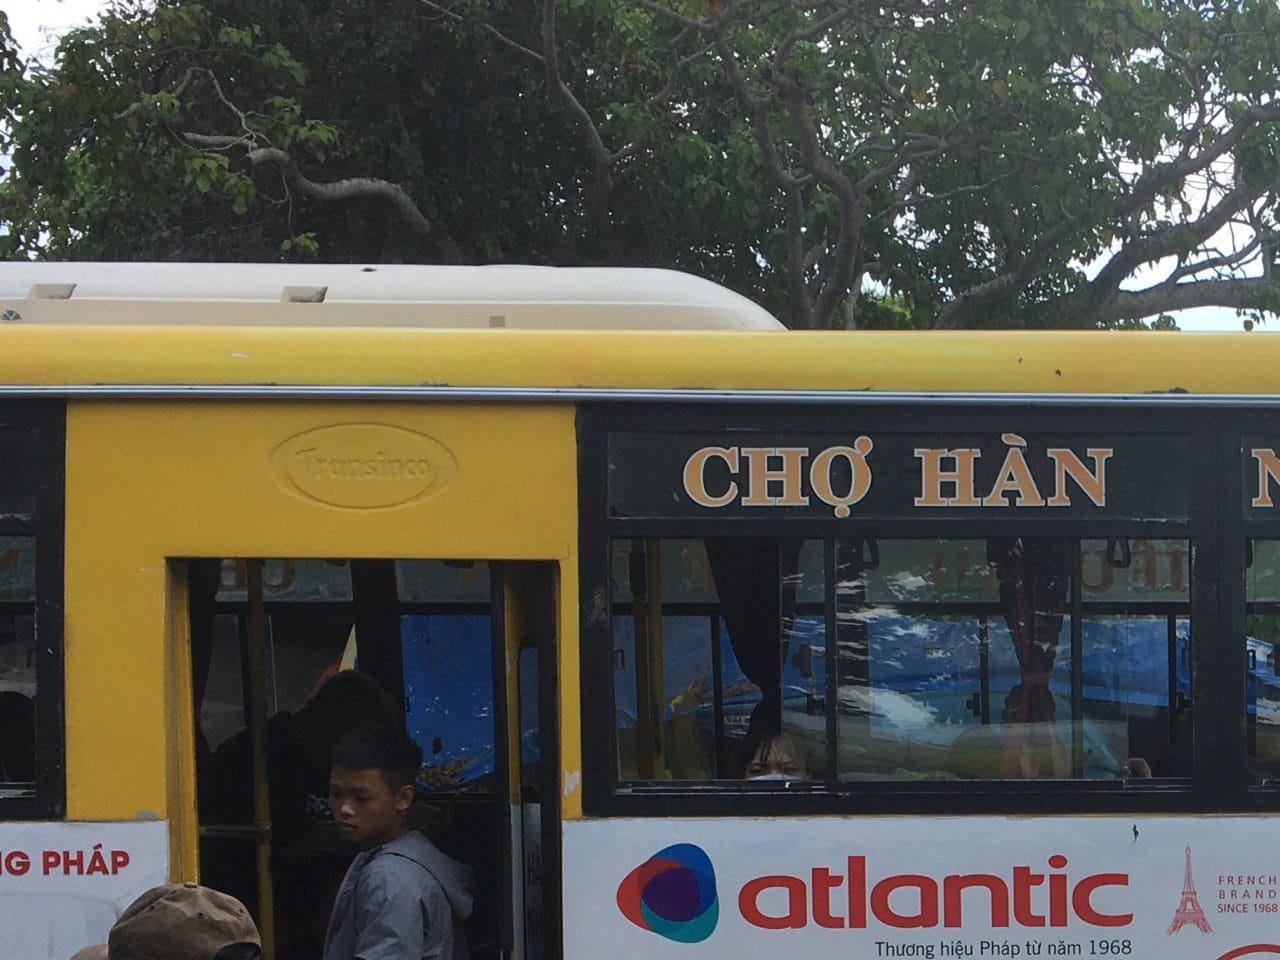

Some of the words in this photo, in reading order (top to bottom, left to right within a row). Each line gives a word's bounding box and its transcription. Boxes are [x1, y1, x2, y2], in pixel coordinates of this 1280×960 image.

[295, 446, 433, 482] Transinco
[682, 435, 874, 518] CHỢ
[914, 432, 1114, 508] HÀN
[42, 843, 130, 876] PHÁP
[738, 854, 1134, 931] atlantic
[1218, 875, 1277, 886] FRENCH
[1218, 889, 1277, 900] BRAND
[1217, 903, 1248, 914] SINCE
[1253, 903, 1279, 914] 1968
[875, 941, 935, 960] Thương
[940, 940, 973, 960] hiệu
[980, 940, 1021, 959] Pháp
[1026, 940, 1042, 956] từ
[1047, 941, 1082, 956] năm
[1089, 939, 1133, 956] 1968
